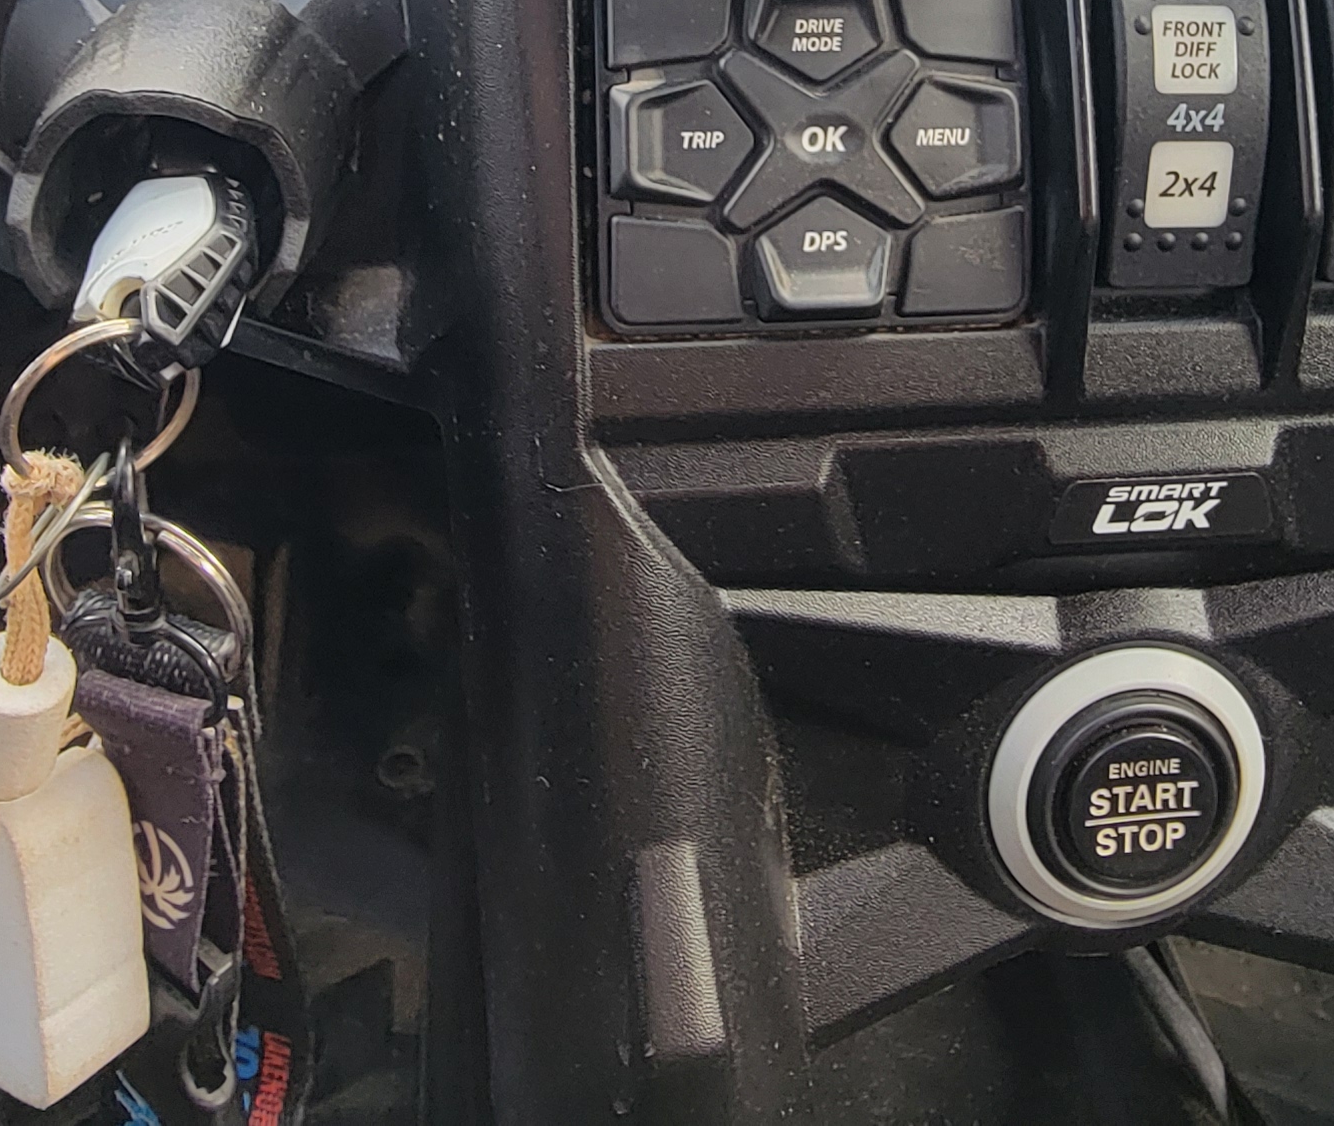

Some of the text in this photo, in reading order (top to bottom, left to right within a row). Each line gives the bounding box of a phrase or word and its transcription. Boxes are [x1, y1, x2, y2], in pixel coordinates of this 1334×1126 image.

[794, 18, 844, 34] DRIVE
[1162, 21, 1226, 39] FRONT
[792, 36, 842, 52] MODE
[1174, 41, 1218, 58] DIFF
[1170, 62, 1221, 80] LOCK
[1167, 103, 1225, 133] 4x4
[681, 131, 724, 149] TRIP
[801, 126, 848, 153] OK
[916, 128, 970, 146] MENU
[1159, 171, 1217, 199] 2x4
[803, 231, 848, 252] DPS
[1105, 481, 1228, 502] SMART
[1092, 499, 1221, 535] LOK
[1108, 759, 1181, 779] ENGINE
[1089, 781, 1199, 817] START
[1095, 823, 1186, 857] STOP
